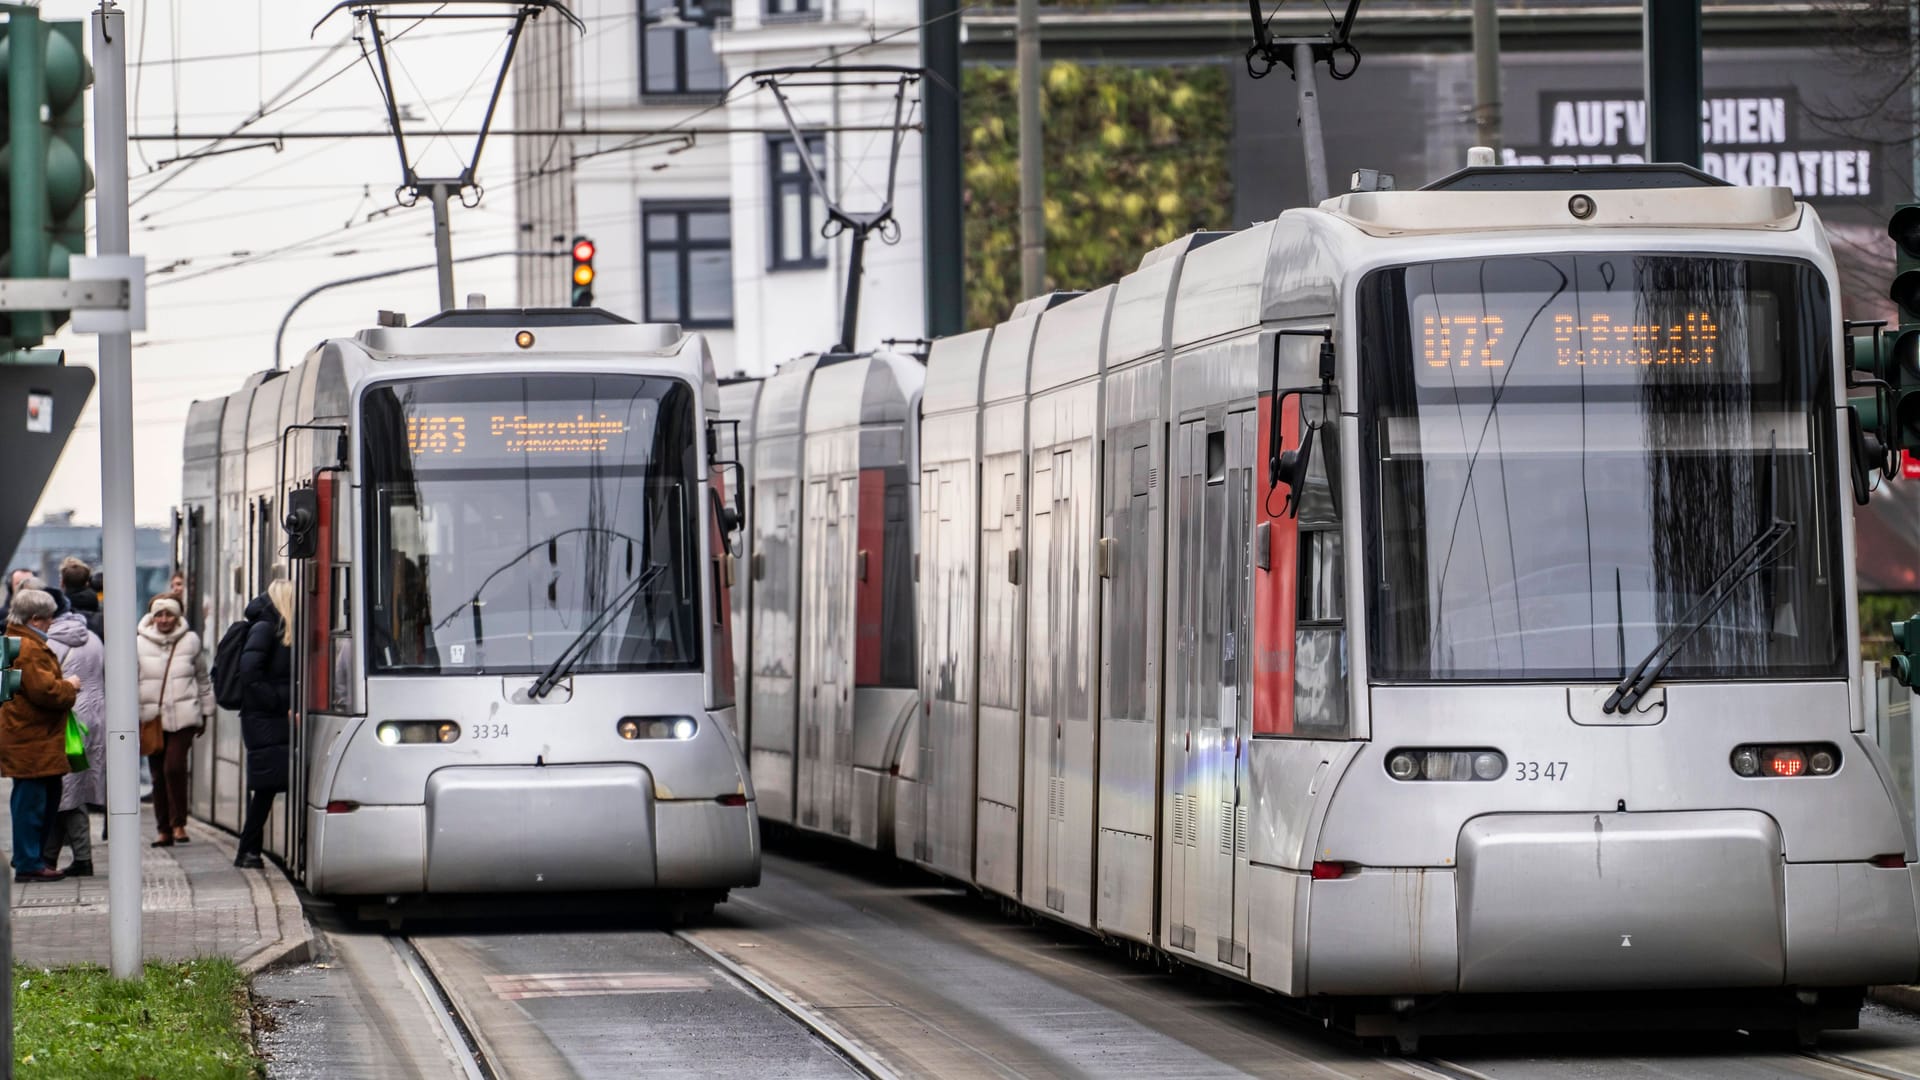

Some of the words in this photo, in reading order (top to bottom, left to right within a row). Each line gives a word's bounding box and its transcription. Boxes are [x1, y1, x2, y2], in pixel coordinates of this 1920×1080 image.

[1424, 315, 1505, 367] U72
[408, 416, 466, 454] U83
[472, 723, 509, 739] 3334
[1515, 761, 1569, 782] 3347
